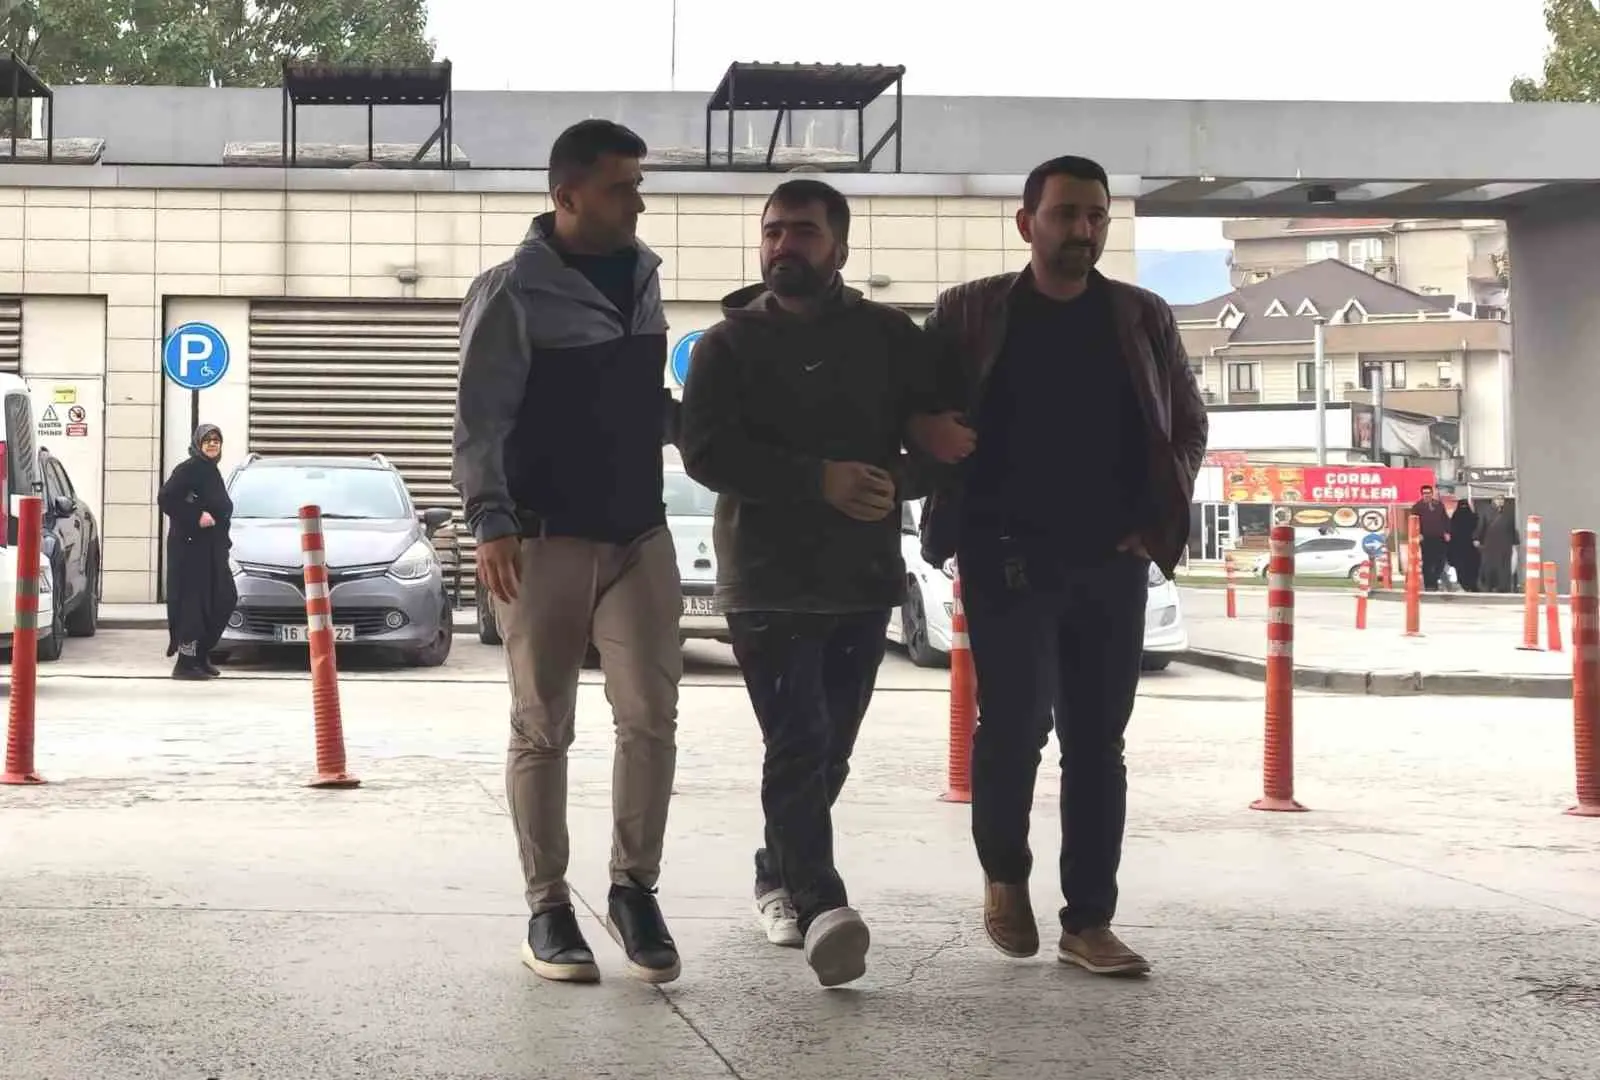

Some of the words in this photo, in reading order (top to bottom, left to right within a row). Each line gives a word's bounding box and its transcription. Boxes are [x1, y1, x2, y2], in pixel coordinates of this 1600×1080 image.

[181, 333, 213, 377] P
[1325, 473, 1382, 488] ÇORBA
[1312, 485, 1398, 502] ÇEŞİTLERİ
[284, 627, 298, 640] 16
